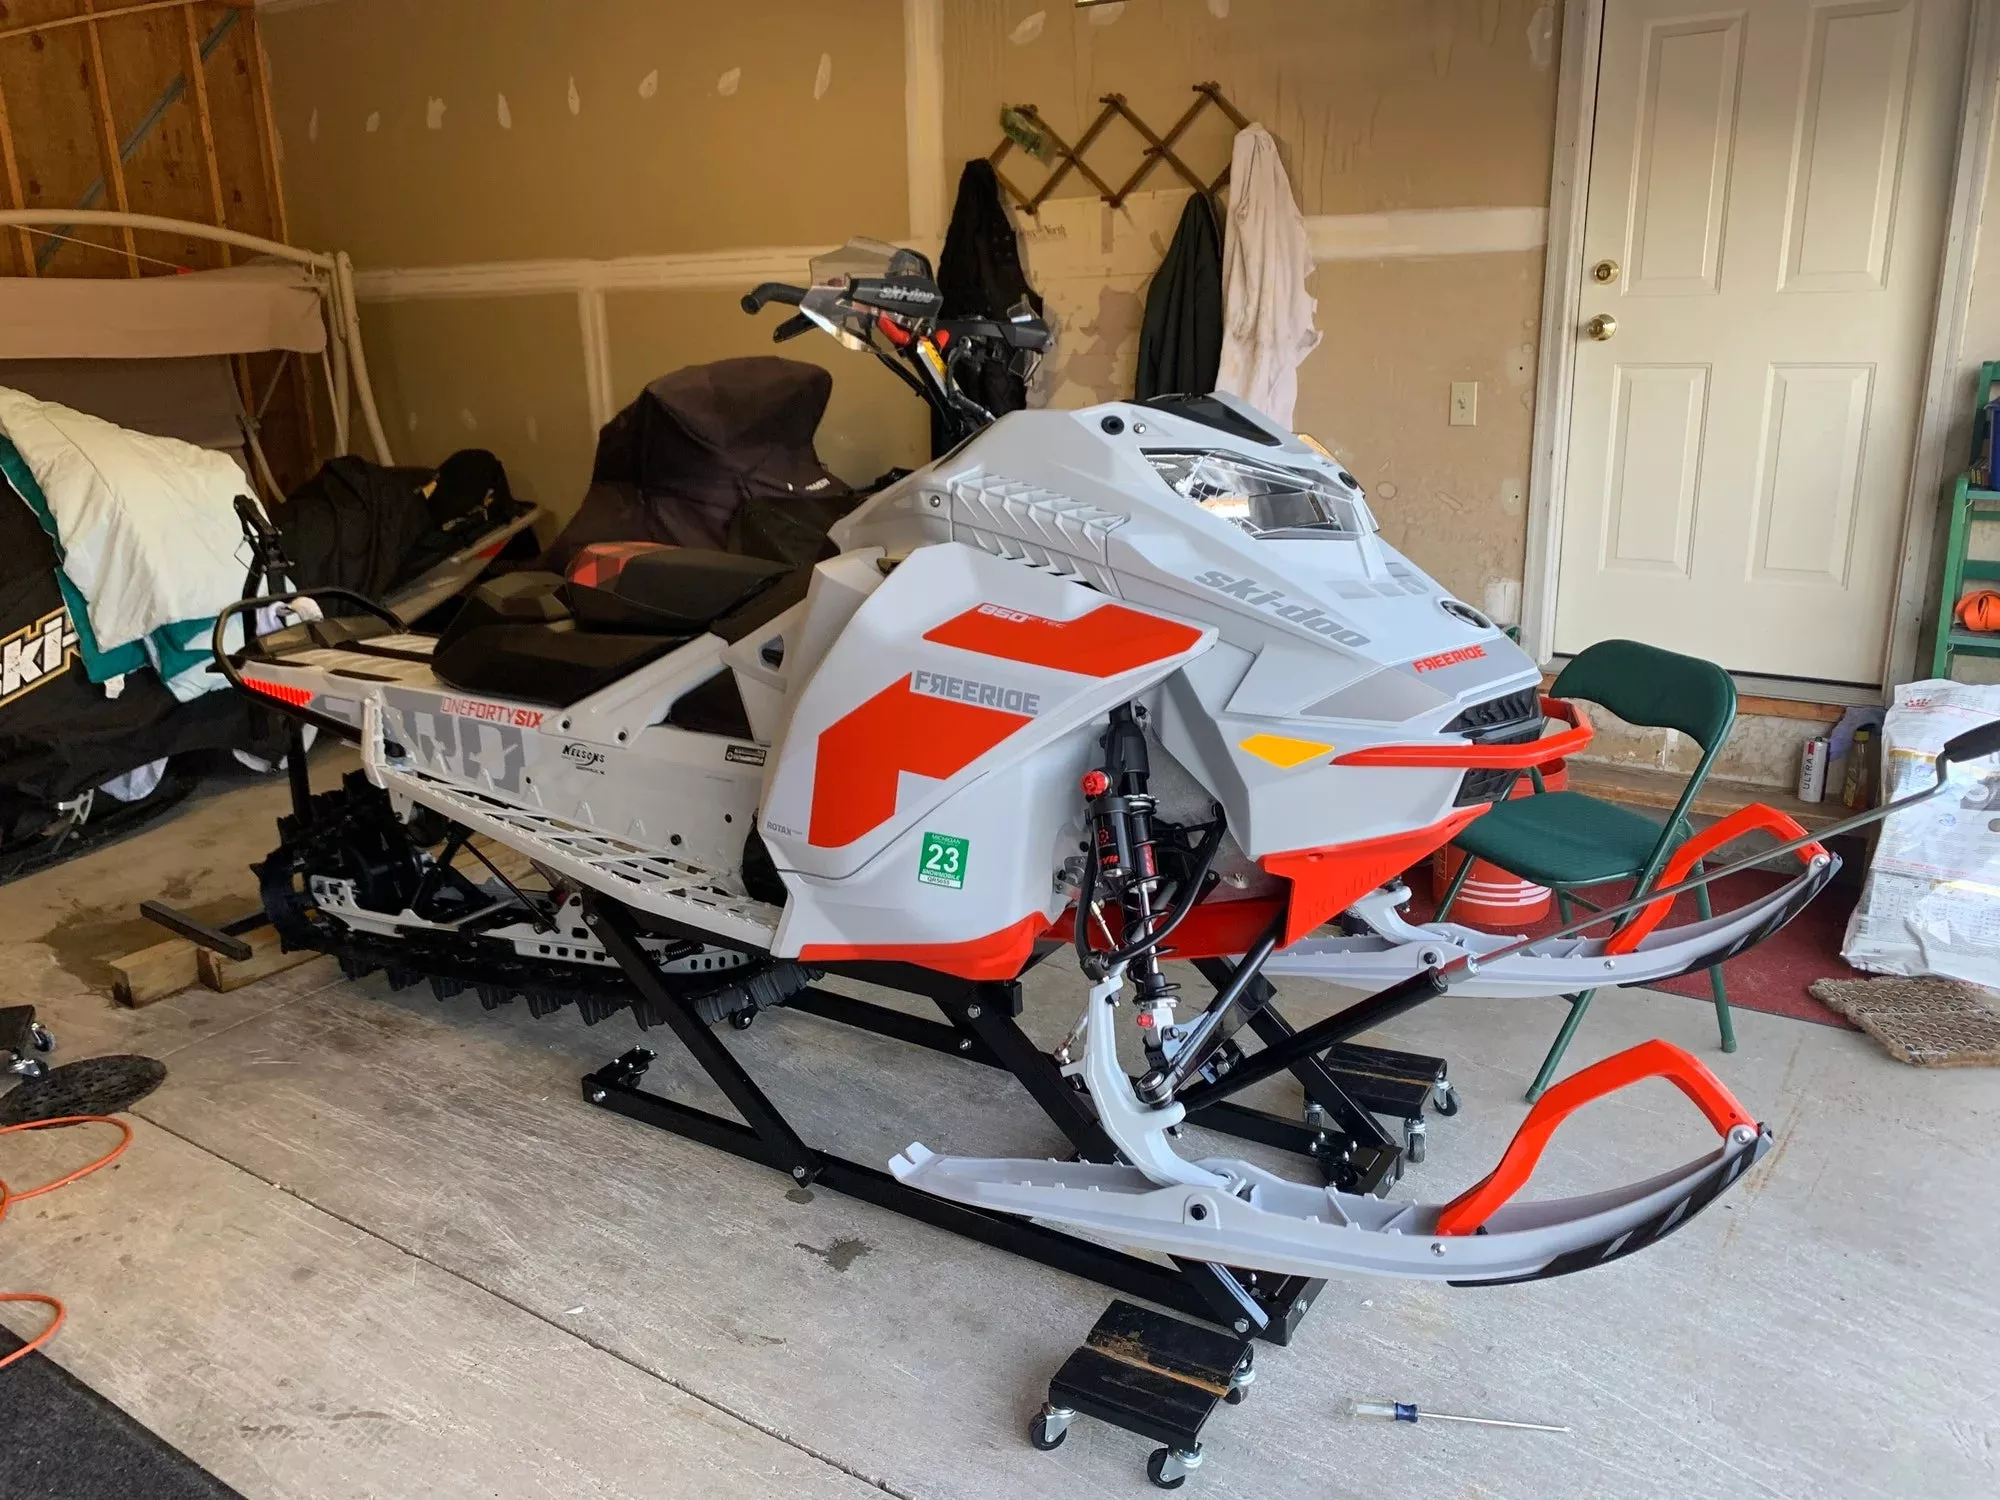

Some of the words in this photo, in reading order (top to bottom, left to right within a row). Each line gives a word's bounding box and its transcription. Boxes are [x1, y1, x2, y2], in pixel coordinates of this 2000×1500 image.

[977, 604, 1029, 623] 850
[1194, 570, 1371, 647] ski-doo
[0, 616, 79, 695] ki-
[914, 669, 1040, 715] FREERIDE
[1802, 758, 1814, 791] ULTRA
[766, 821, 792, 836] ROTAX
[921, 868, 961, 881] SNOWMOBILE
[925, 843, 960, 874] 23
